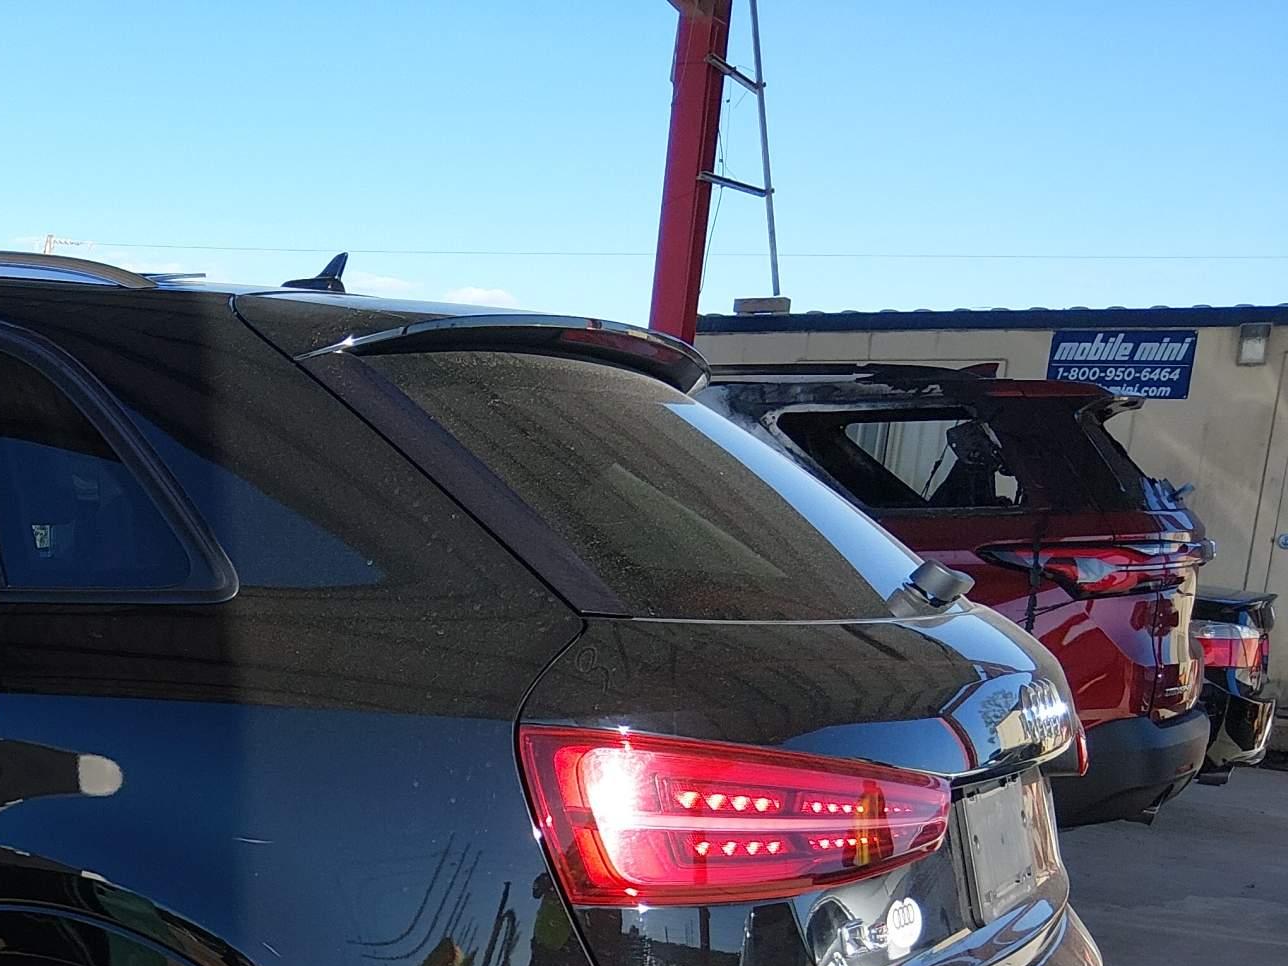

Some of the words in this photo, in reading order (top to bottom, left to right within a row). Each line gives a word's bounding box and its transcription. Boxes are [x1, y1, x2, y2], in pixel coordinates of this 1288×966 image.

[1053, 333, 1134, 361] mobile
[1133, 337, 1192, 361] mini
[1056, 367, 1181, 381] 1-800-950-6464
